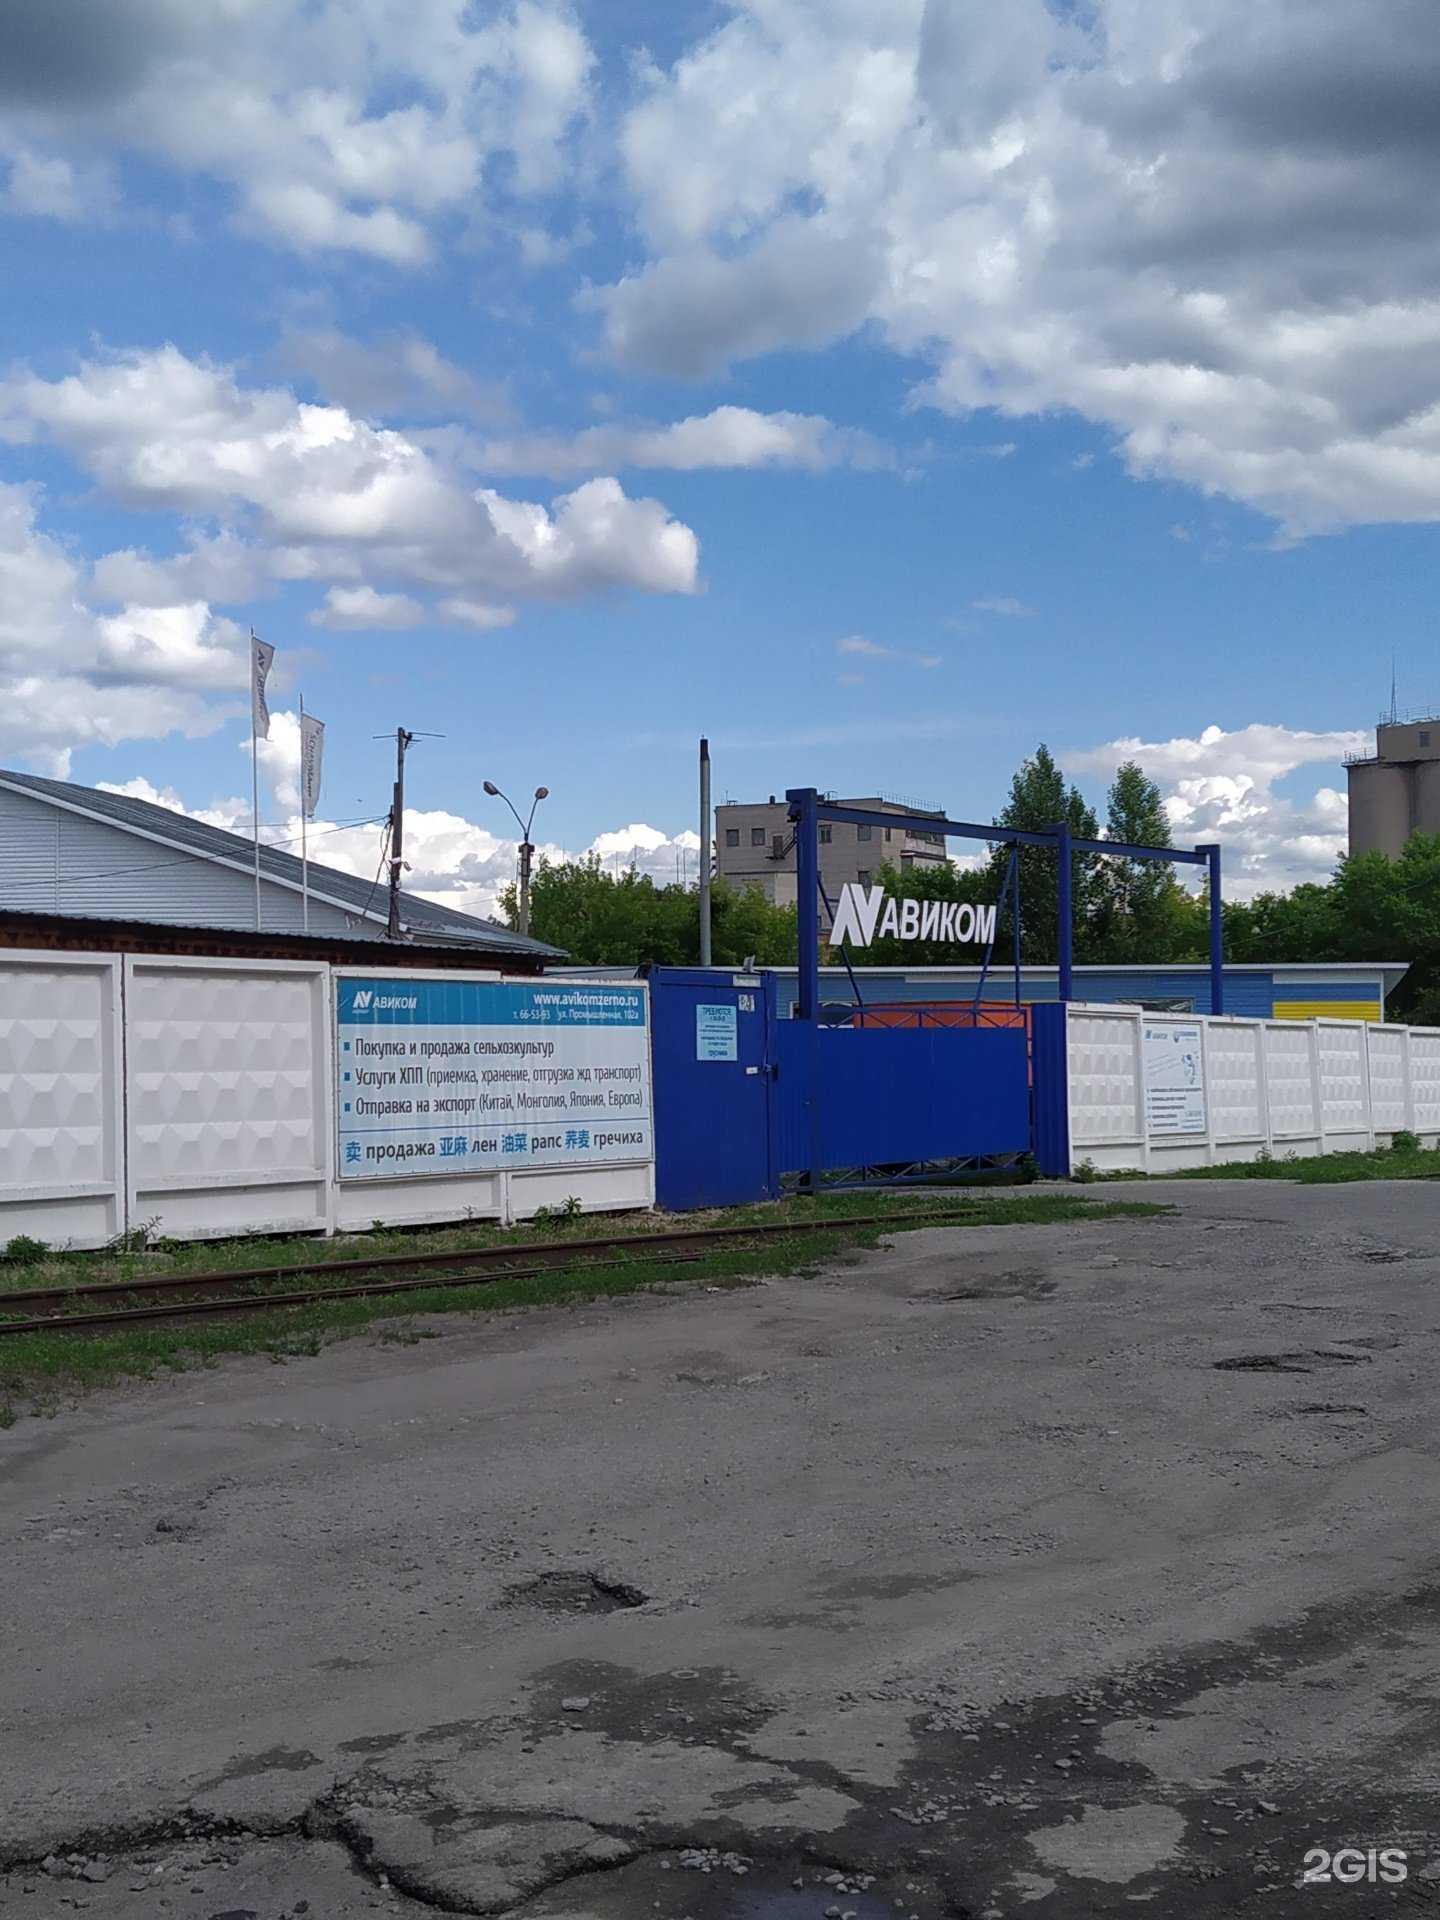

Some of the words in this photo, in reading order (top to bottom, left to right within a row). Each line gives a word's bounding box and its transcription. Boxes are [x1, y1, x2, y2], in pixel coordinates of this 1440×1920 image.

[878, 897, 997, 945] АВИКОМ
[372, 996, 417, 1009] АВИКОМ
[533, 991, 639, 1007] www.avikomzerno.ru
[355, 1038, 406, 1060] Покупка
[409, 1043, 417, 1055] и
[420, 1041, 470, 1059] продажа
[473, 1041, 555, 1058] сельхозкультур
[355, 1067, 396, 1089] Услуги
[399, 1066, 423, 1085] ХПП
[426, 1064, 479, 1087] (приемка,
[481, 1068, 531, 1086] хранение,
[533, 1067, 575, 1085] отгрузка
[594, 1064, 642, 1083] транспорт)
[355, 1096, 413, 1119] Отправка
[416, 1101, 430, 1113] на
[433, 1098, 477, 1115] экспорт
[479, 1092, 515, 1112] (Китай,
[516, 1091, 568, 1111] Монголия,
[569, 1090, 606, 1108] Япония,
[608, 1088, 643, 1109] Европа)
[366, 1141, 436, 1164] продажа
[471, 1138, 498, 1153] лен
[531, 1134, 563, 1154] рапс
[593, 1131, 644, 1150] гречиха
